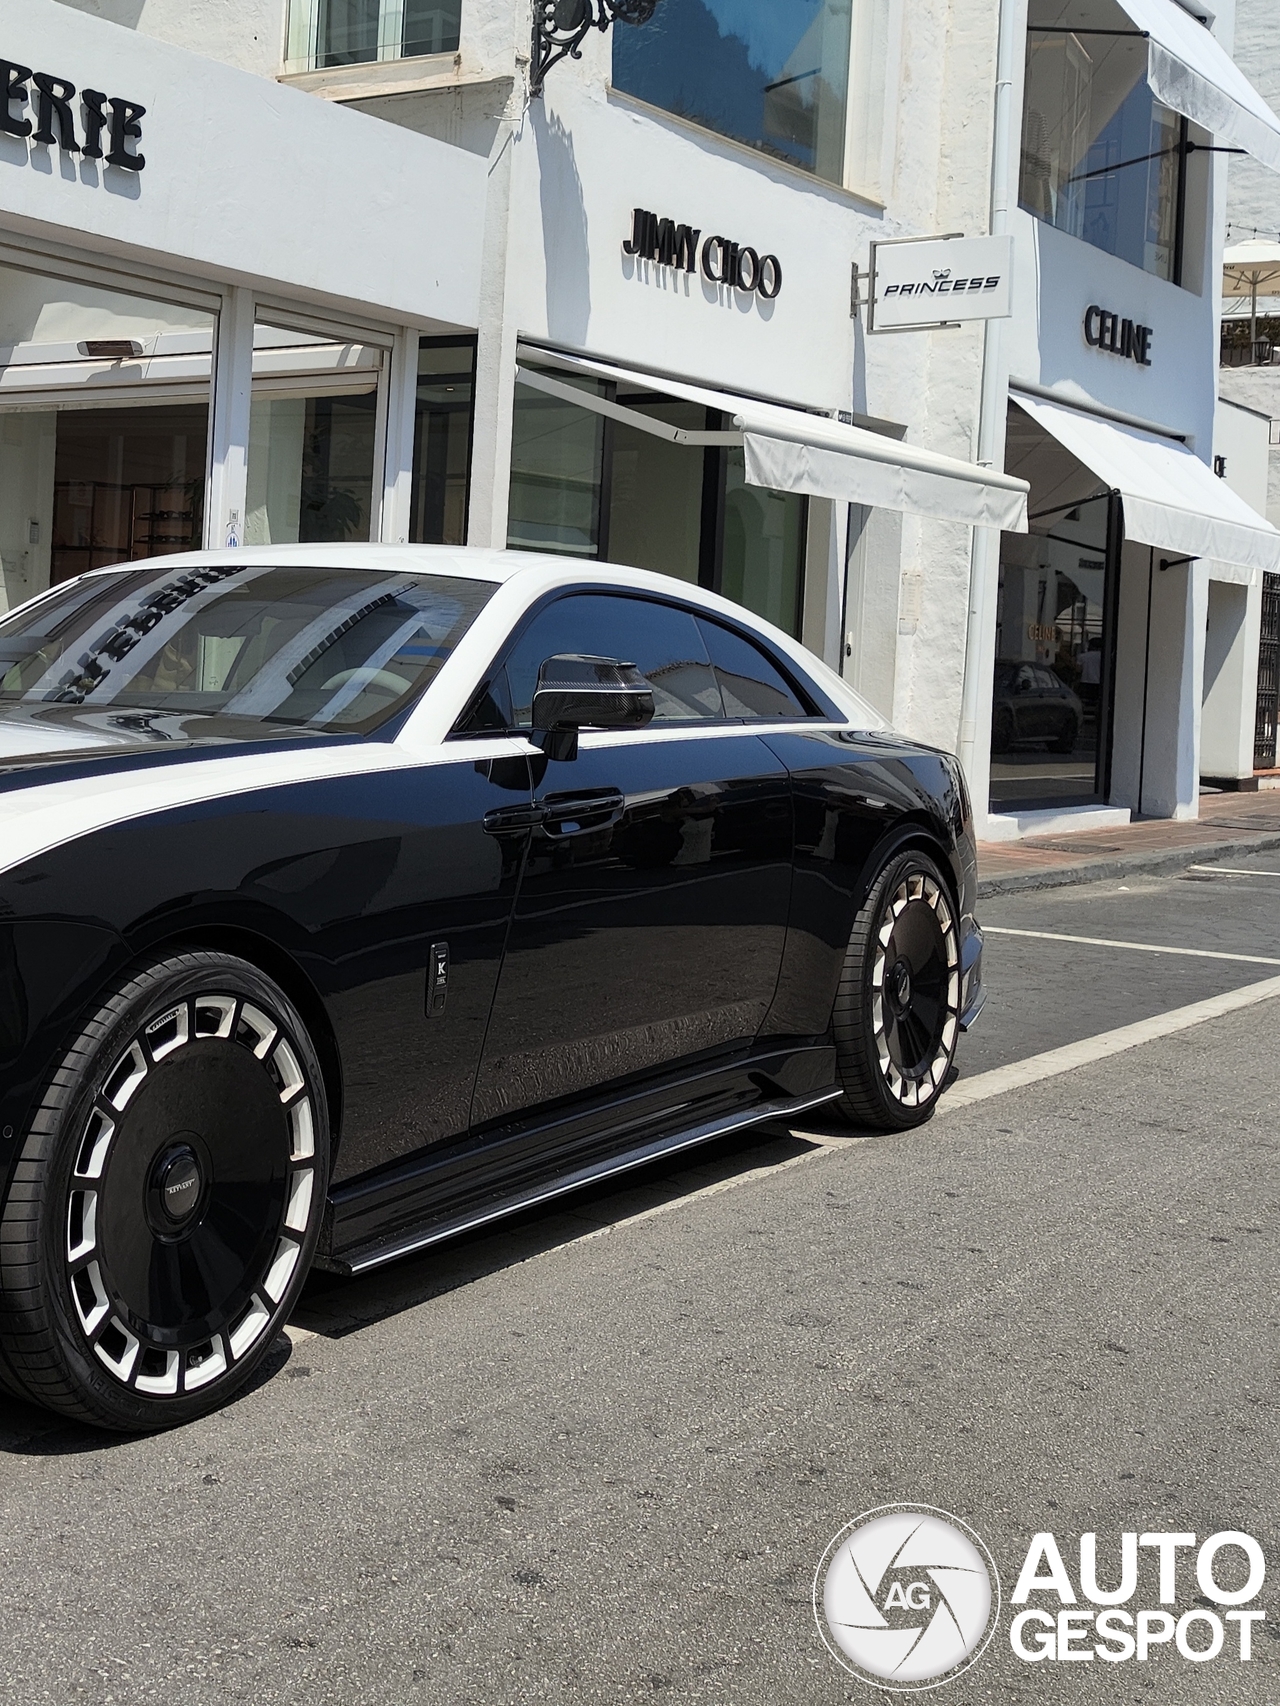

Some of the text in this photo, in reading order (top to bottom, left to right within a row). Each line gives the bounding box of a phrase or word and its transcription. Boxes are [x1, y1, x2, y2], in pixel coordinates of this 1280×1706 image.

[622, 208, 783, 299] JIMMY CHOO
[883, 276, 1001, 297] PRINCESS
[1084, 304, 1154, 367] CELINE
[1028, 624, 1055, 641] CELINE
[437, 961, 447, 976] K
